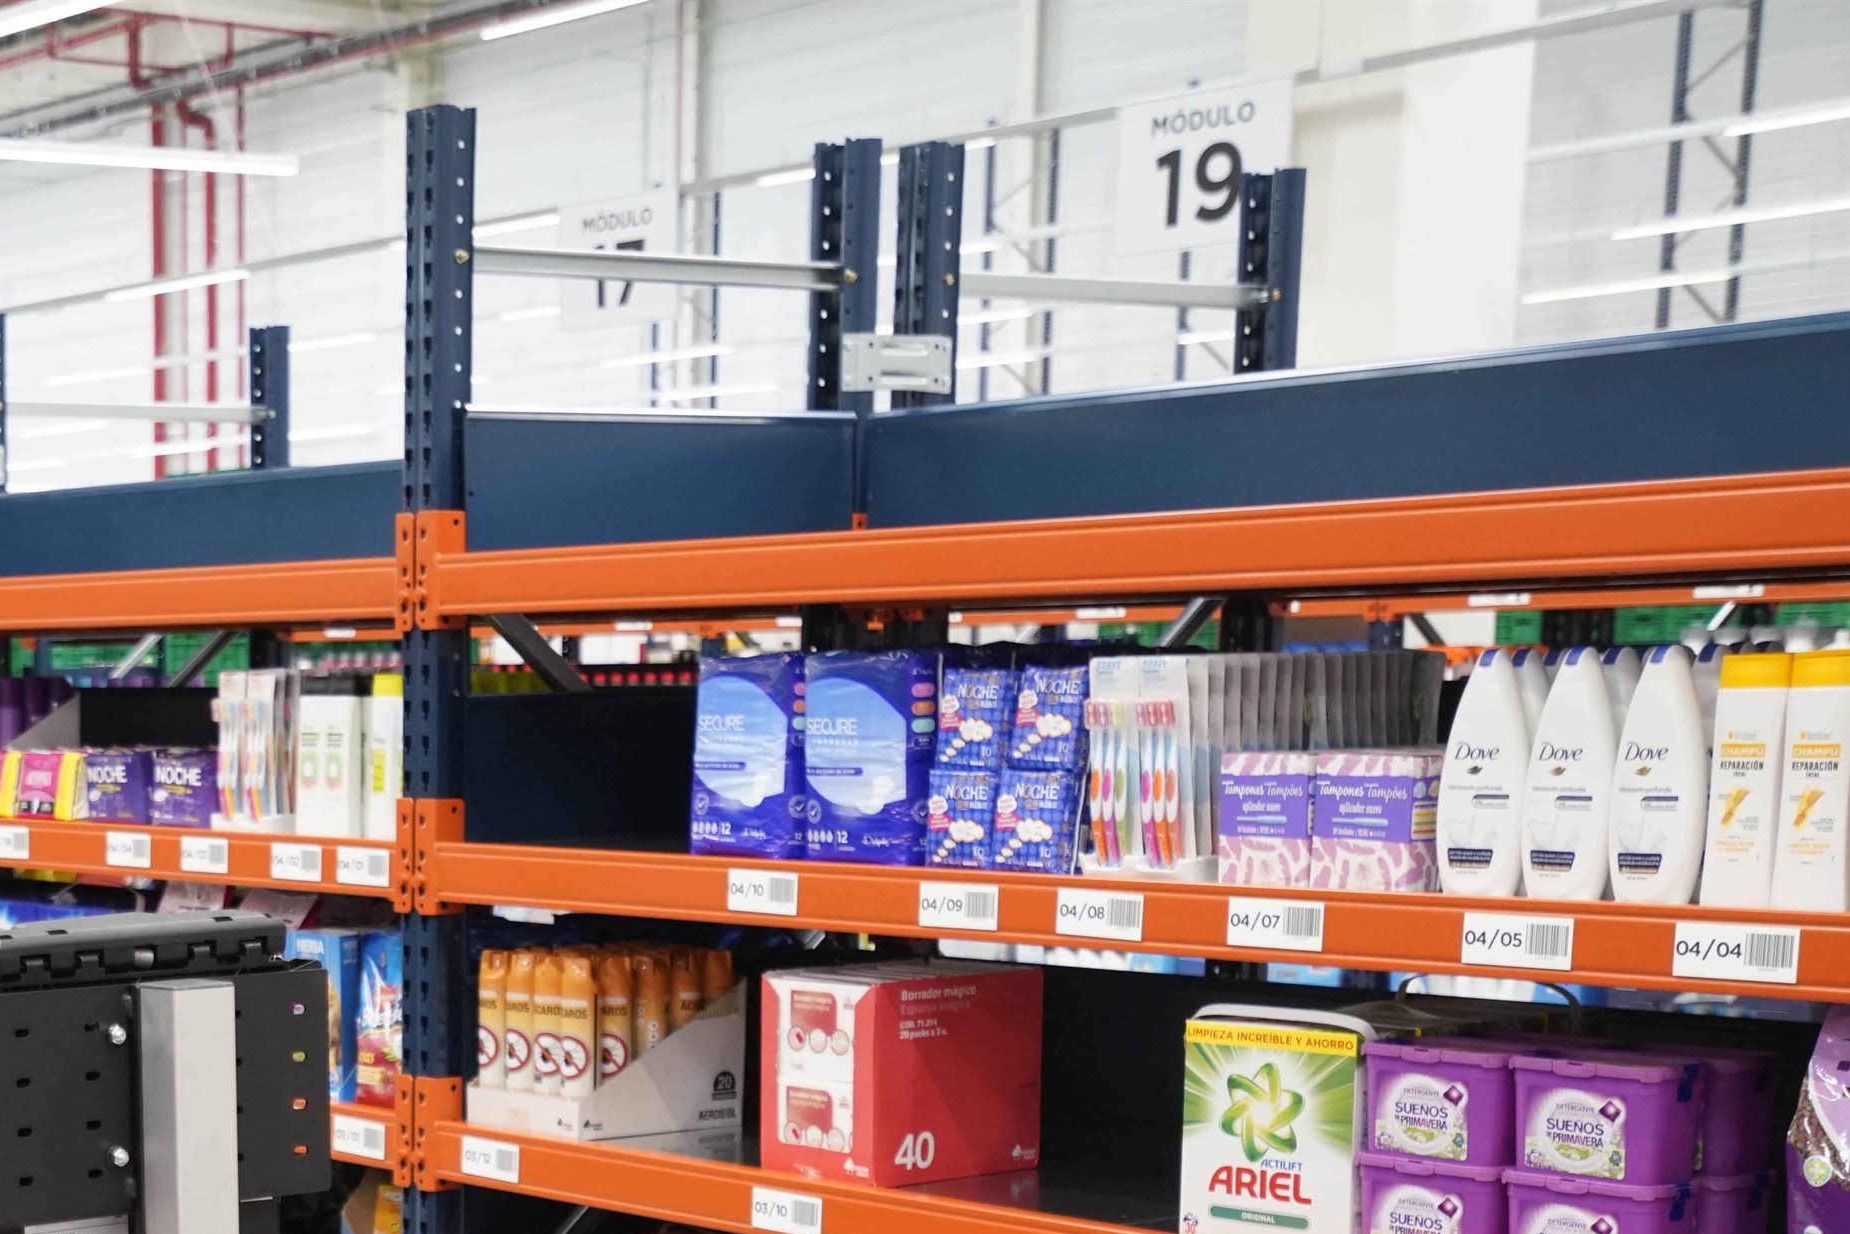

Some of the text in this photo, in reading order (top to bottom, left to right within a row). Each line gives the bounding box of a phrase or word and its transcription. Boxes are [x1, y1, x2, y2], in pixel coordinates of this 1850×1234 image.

[1150, 100, 1255, 136] MÓDULO
[1156, 140, 1242, 227] 19
[582, 206, 654, 235] MÓDULO
[594, 240, 647, 308] 17
[958, 683, 999, 699] NOCHE
[1037, 679, 1081, 694] NOCHE
[700, 714, 745, 732] SECURE
[807, 718, 858, 736] SECURE
[1454, 741, 1500, 761] Dove
[1539, 741, 1583, 761] Dove
[1624, 741, 1669, 761] Dove
[87, 765, 127, 783] NOCHE
[1720, 760, 1764, 770] REPARACIÓN
[1791, 760, 1839, 772] REPARACIÓN
[155, 765, 202, 786] NOCHE
[945, 785, 989, 800] NOCHE
[1015, 783, 1060, 800] NOCHE
[1222, 780, 1264, 799] Tampones
[1317, 780, 1408, 802] Tampones Tampões
[837, 830, 849, 844] 12
[730, 882, 765, 898] 04/10
[921, 898, 964, 914] 04/09
[1060, 903, 1106, 921] 04/08
[1230, 912, 1280, 931] 04/07
[1464, 929, 1523, 949] 04/05
[1676, 939, 1743, 960] 04/04
[901, 988, 942, 1001] Borrador
[1187, 1028, 1354, 1050] LIMPIEZA INCREÍBLE Y AHORRO
[718, 1076, 731, 1089] 20
[1556, 1103, 1596, 1114] DETERGENTE
[1400, 1115, 1448, 1131] PRIMAVERA
[1552, 1131, 1604, 1148] PRIMAVERA
[464, 1149, 492, 1165] 03/12
[894, 1131, 936, 1171] 40
[1260, 1158, 1304, 1172] ACTILIFT
[1208, 1165, 1312, 1206] ARIEL
[754, 1202, 789, 1219] 03/10
[1241, 1211, 1276, 1225] ORIGINAL
